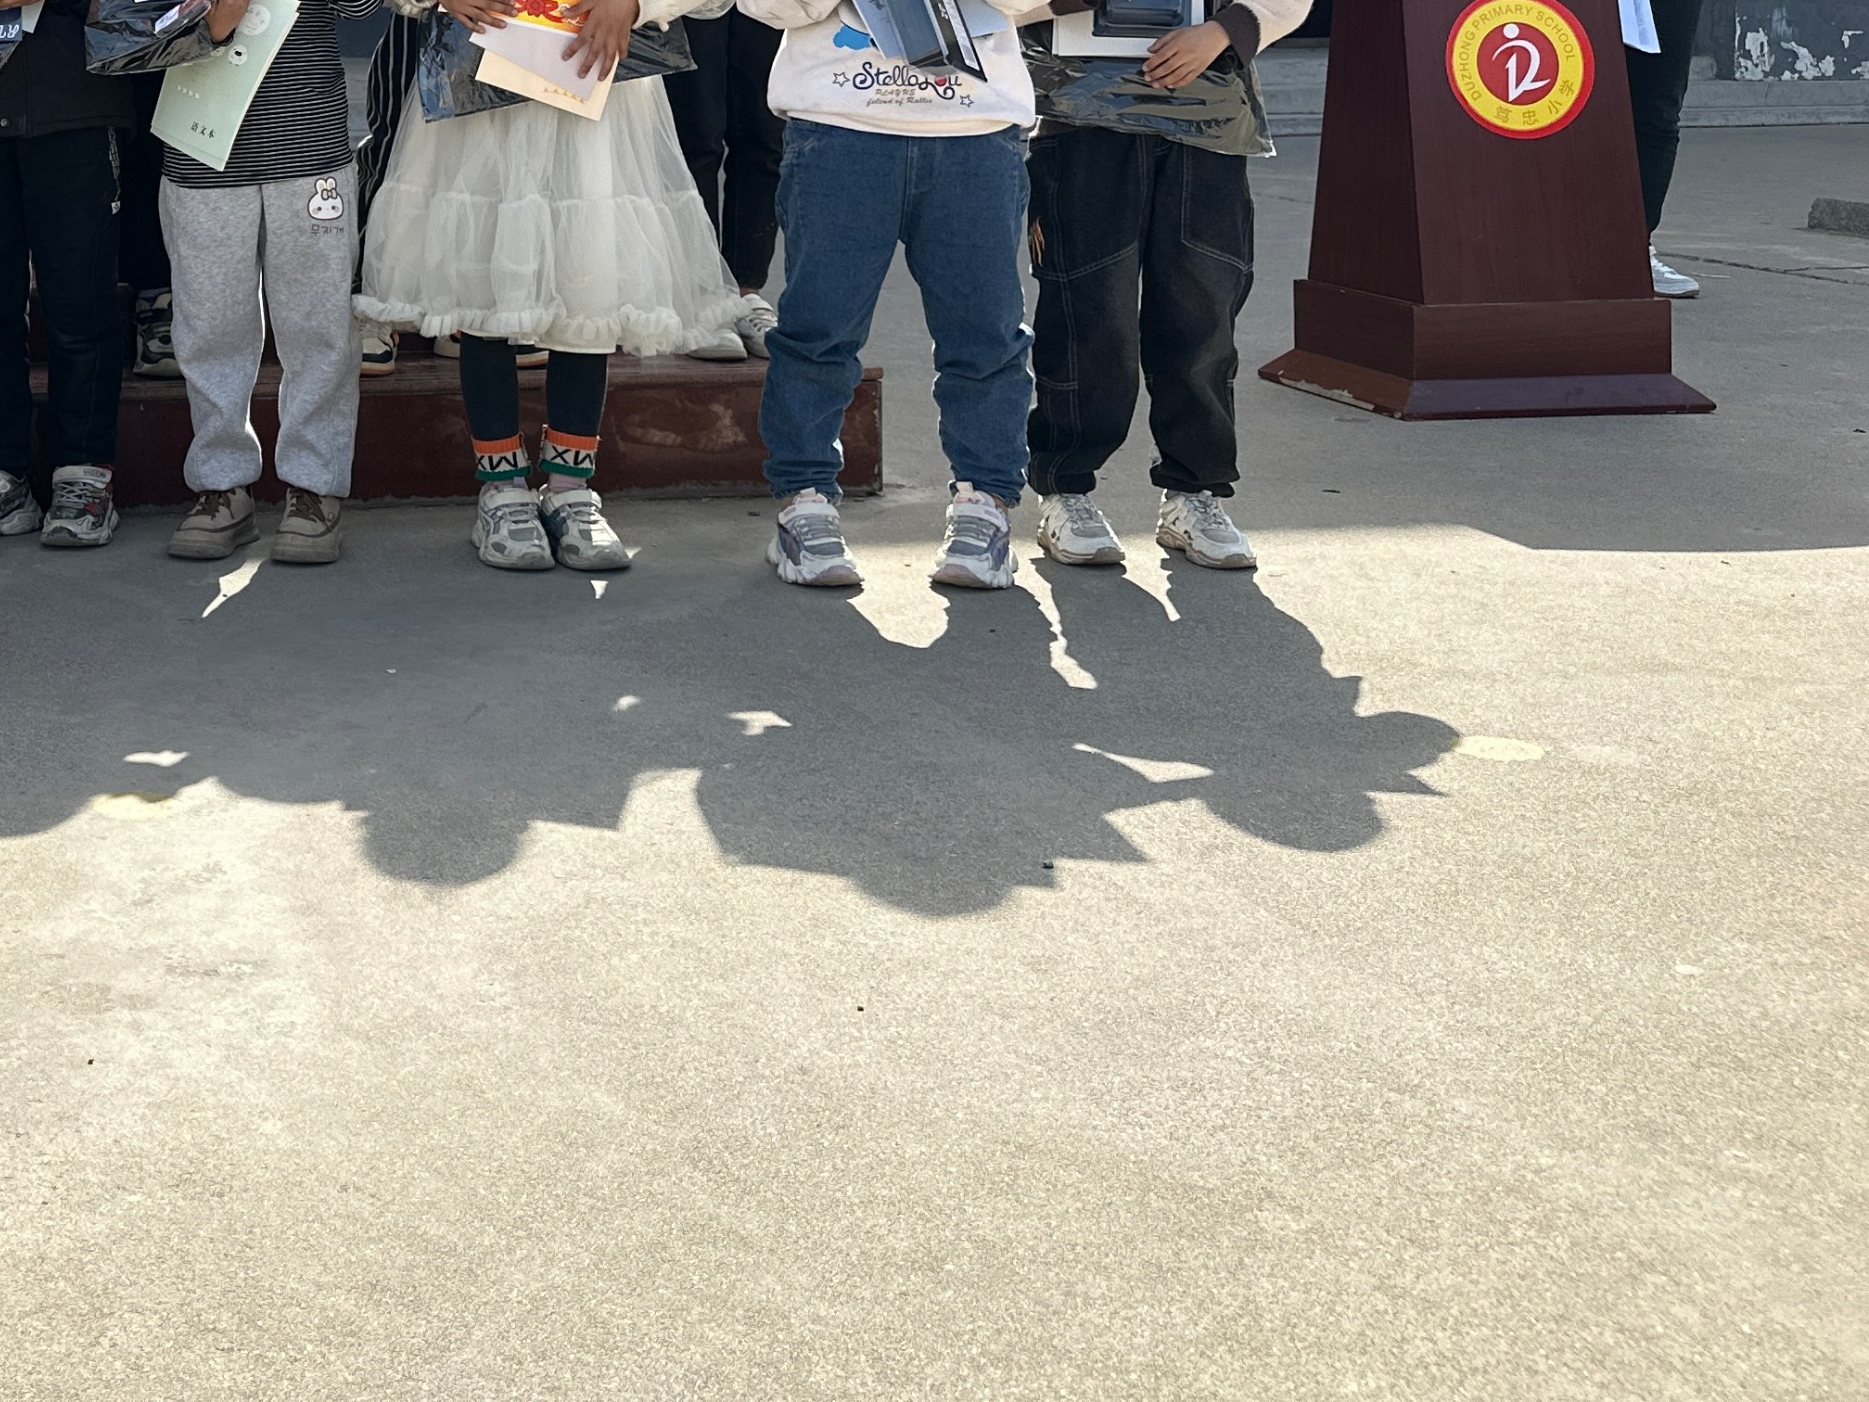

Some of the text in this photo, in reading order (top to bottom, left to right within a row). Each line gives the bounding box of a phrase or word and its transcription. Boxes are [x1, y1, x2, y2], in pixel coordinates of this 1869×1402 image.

[1458, 29, 1482, 102] DUZHONG
[1471, 4, 1534, 32] PRIMARY
[1535, 10, 1576, 63] SCHOOL
